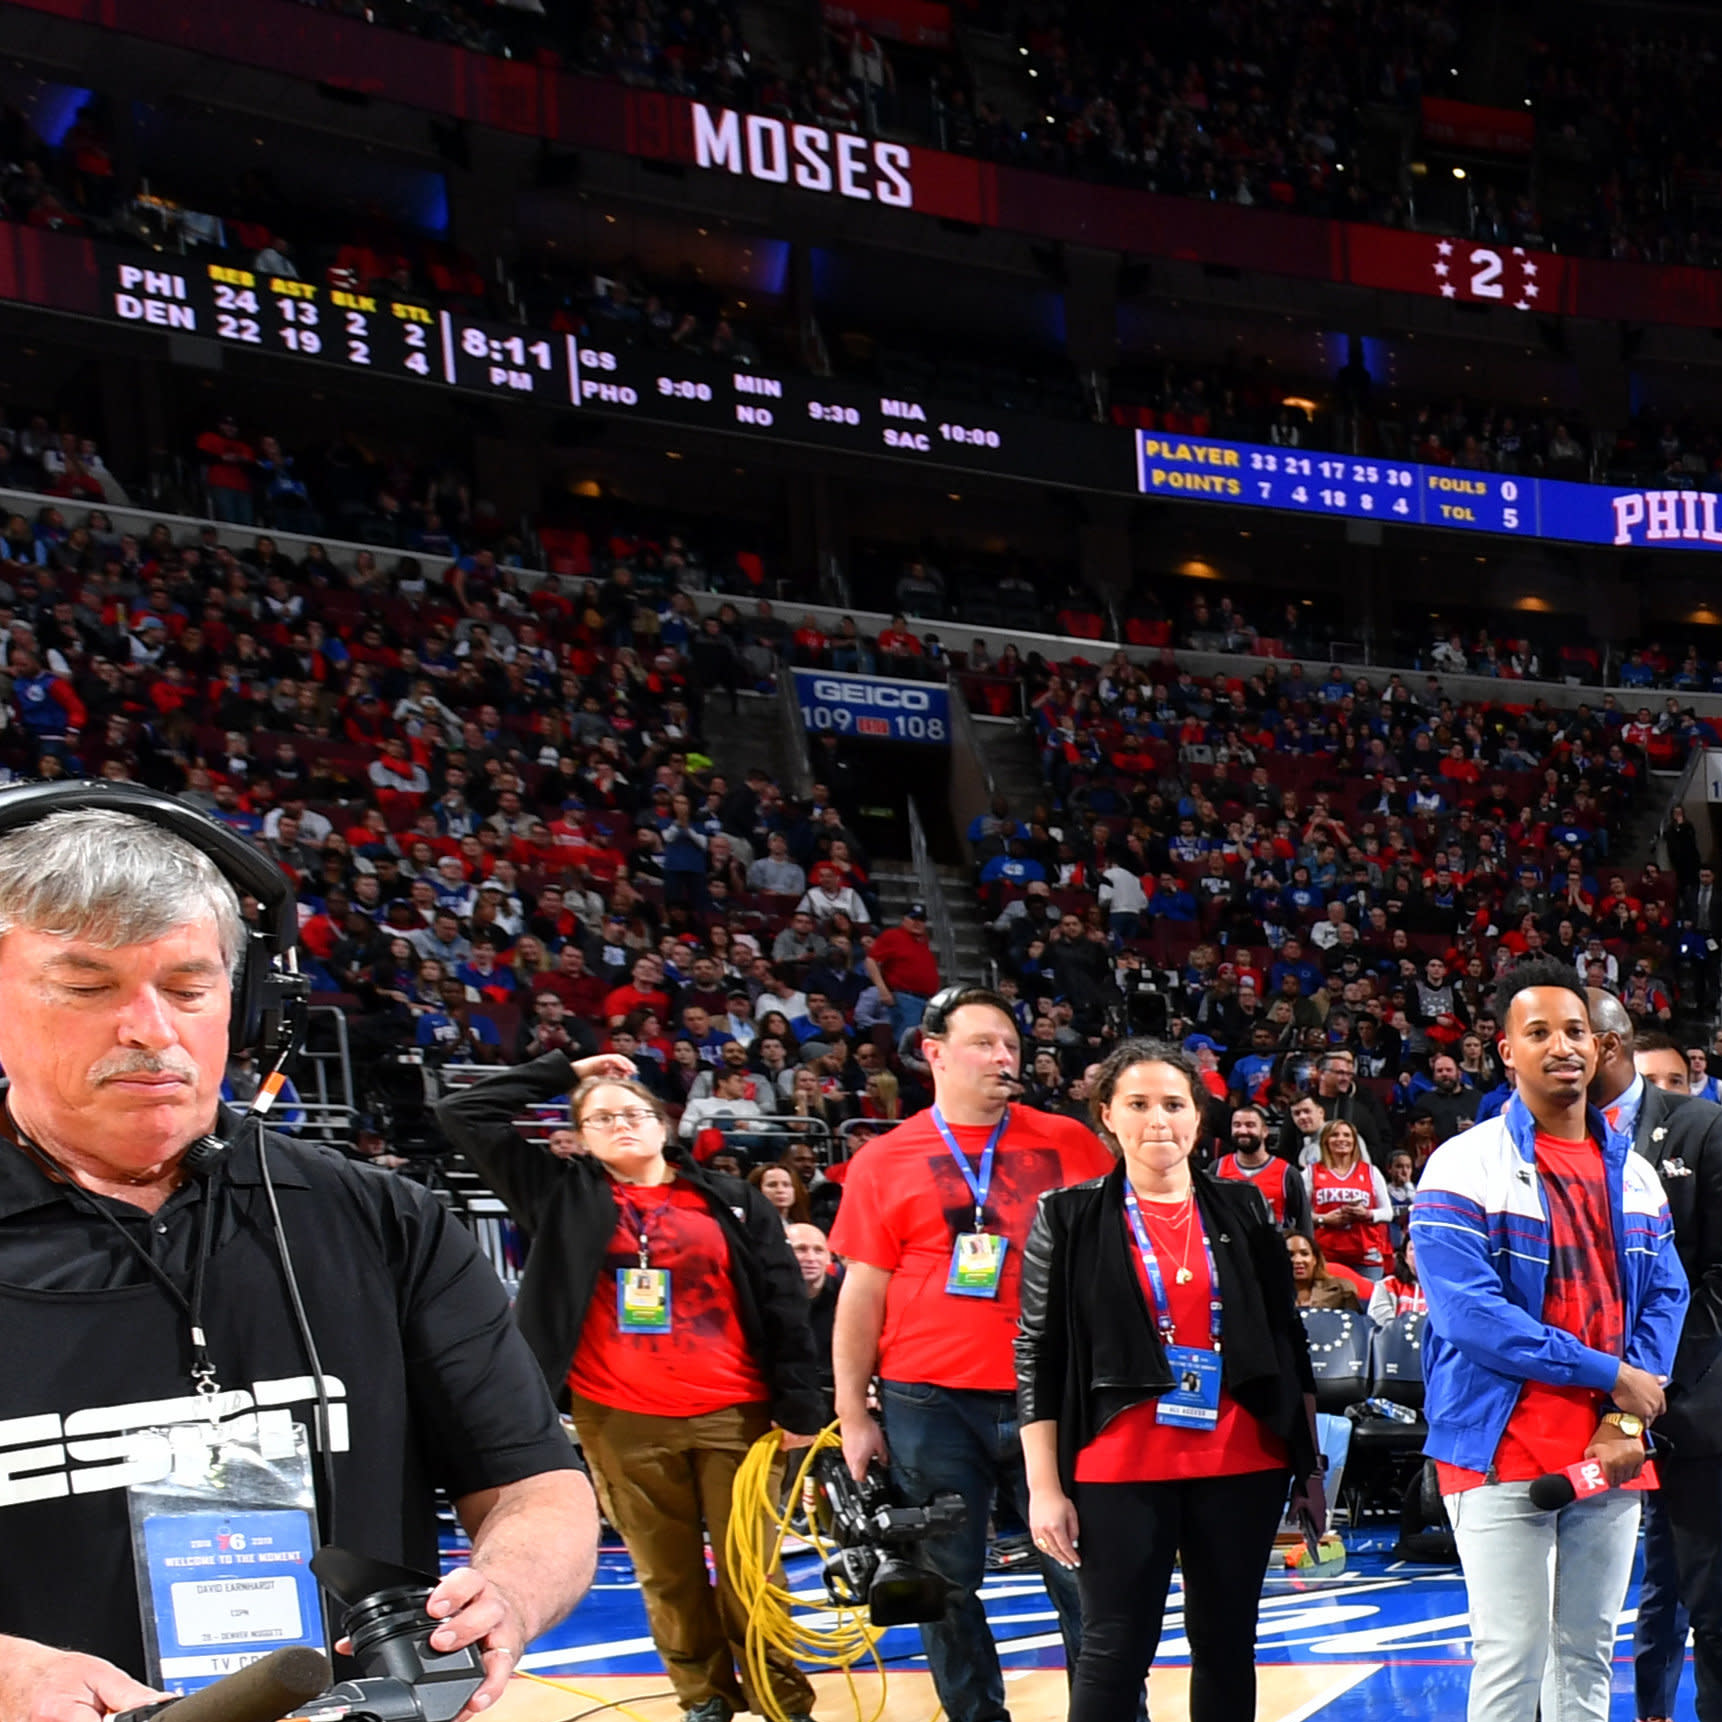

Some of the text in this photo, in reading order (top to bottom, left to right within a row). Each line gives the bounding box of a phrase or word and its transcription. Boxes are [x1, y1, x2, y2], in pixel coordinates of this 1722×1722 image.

[691, 101, 913, 209] MOSES
[1468, 247, 1504, 298] 2
[118, 264, 427, 348] PHI 24 13 2 2
[208, 264, 434, 324] REB AST BLK STL
[115, 293, 430, 376] DEN 22 19 2 4
[462, 327, 553, 371] 8:11
[580, 349, 617, 372] GS
[489, 367, 533, 392] PM
[580, 379, 638, 406] PHO
[657, 376, 712, 402] 9:00
[734, 373, 783, 398] MIN
[736, 405, 774, 427] NO
[809, 401, 860, 426] 9:30
[880, 398, 927, 422] MIA
[883, 428, 931, 452] SAC
[939, 422, 1001, 450] 10:00
[1145, 439, 1412, 487] PLAYER 33 21 17 25 30
[1151, 469, 1410, 515] POINTS 7 4 18 8 4
[1428, 475, 1518, 501] FOULS 0
[1440, 504, 1519, 529] TOL 5
[813, 679, 929, 711] GEICO
[801, 706, 852, 731] 109
[895, 716, 945, 740] 108
[1316, 1187, 1370, 1207] SIXERS
[216, 1533, 246, 1551] 76
[197, 1583, 222, 1594] DAVID
[211, 1657, 230, 1671] TV
